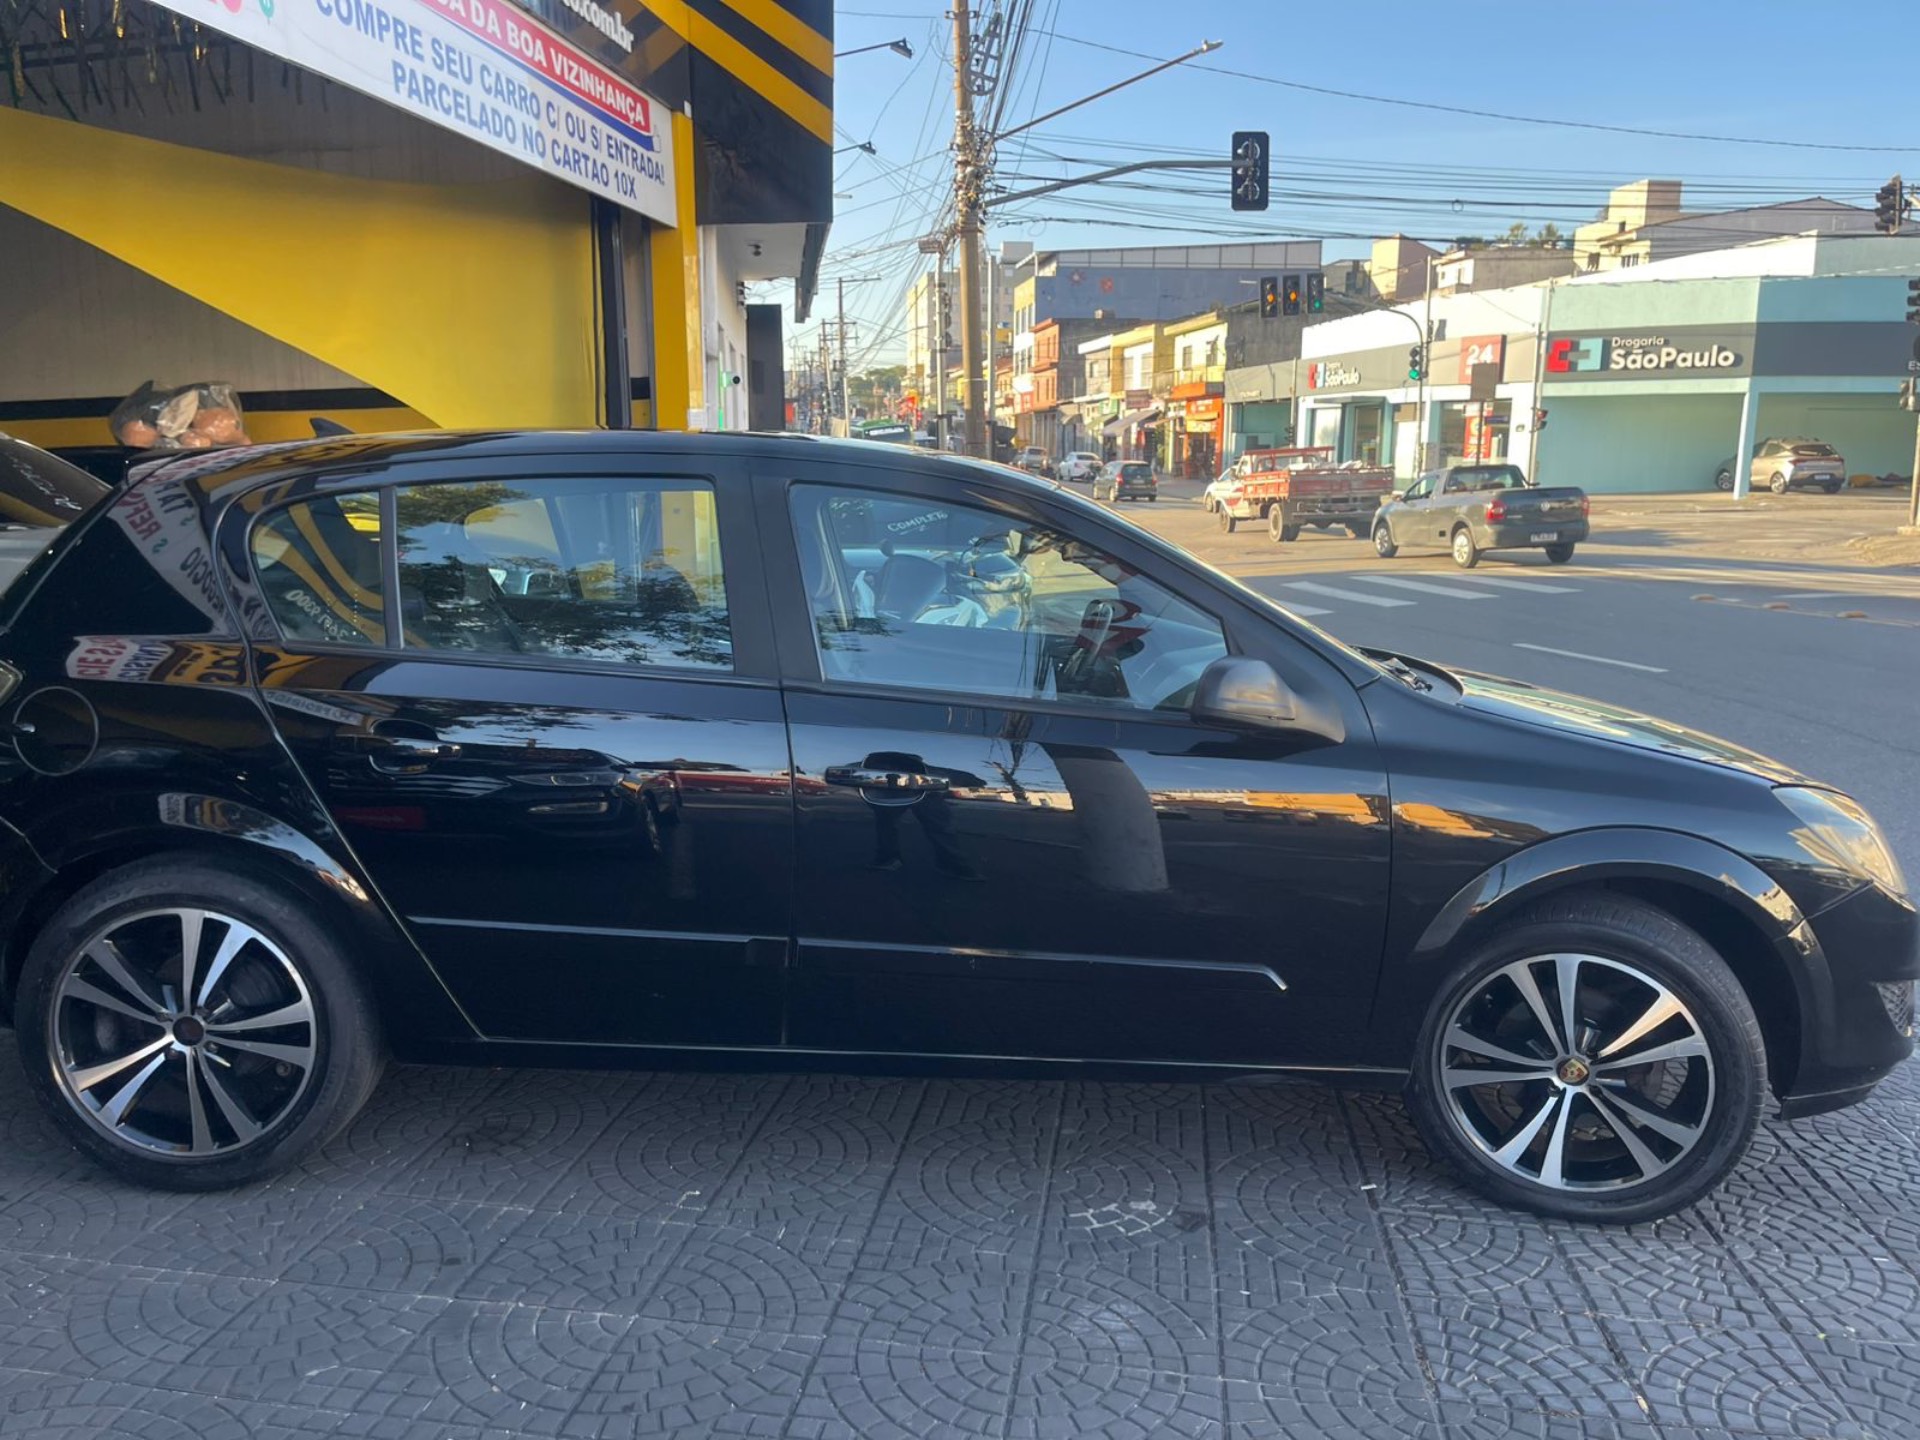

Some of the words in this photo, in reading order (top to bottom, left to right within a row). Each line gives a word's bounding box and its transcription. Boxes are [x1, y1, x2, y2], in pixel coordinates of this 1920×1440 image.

[470, 0, 502, 39] DA
[506, 20, 547, 67] BOA
[550, 46, 645, 126] VIZINHANÇA
[392, 59, 516, 144] PARCELADO
[522, 122, 547, 159] NO
[614, 170, 637, 199] 10X
[431, 37, 473, 85] SEU
[480, 63, 541, 121] CARRO
[565, 111, 586, 143] OU
[606, 133, 665, 186] ENTRADA!
[1465, 343, 1494, 366] 24
[1610, 344, 1735, 371] SãoPaulo
[1611, 336, 1664, 349] Drogaria
